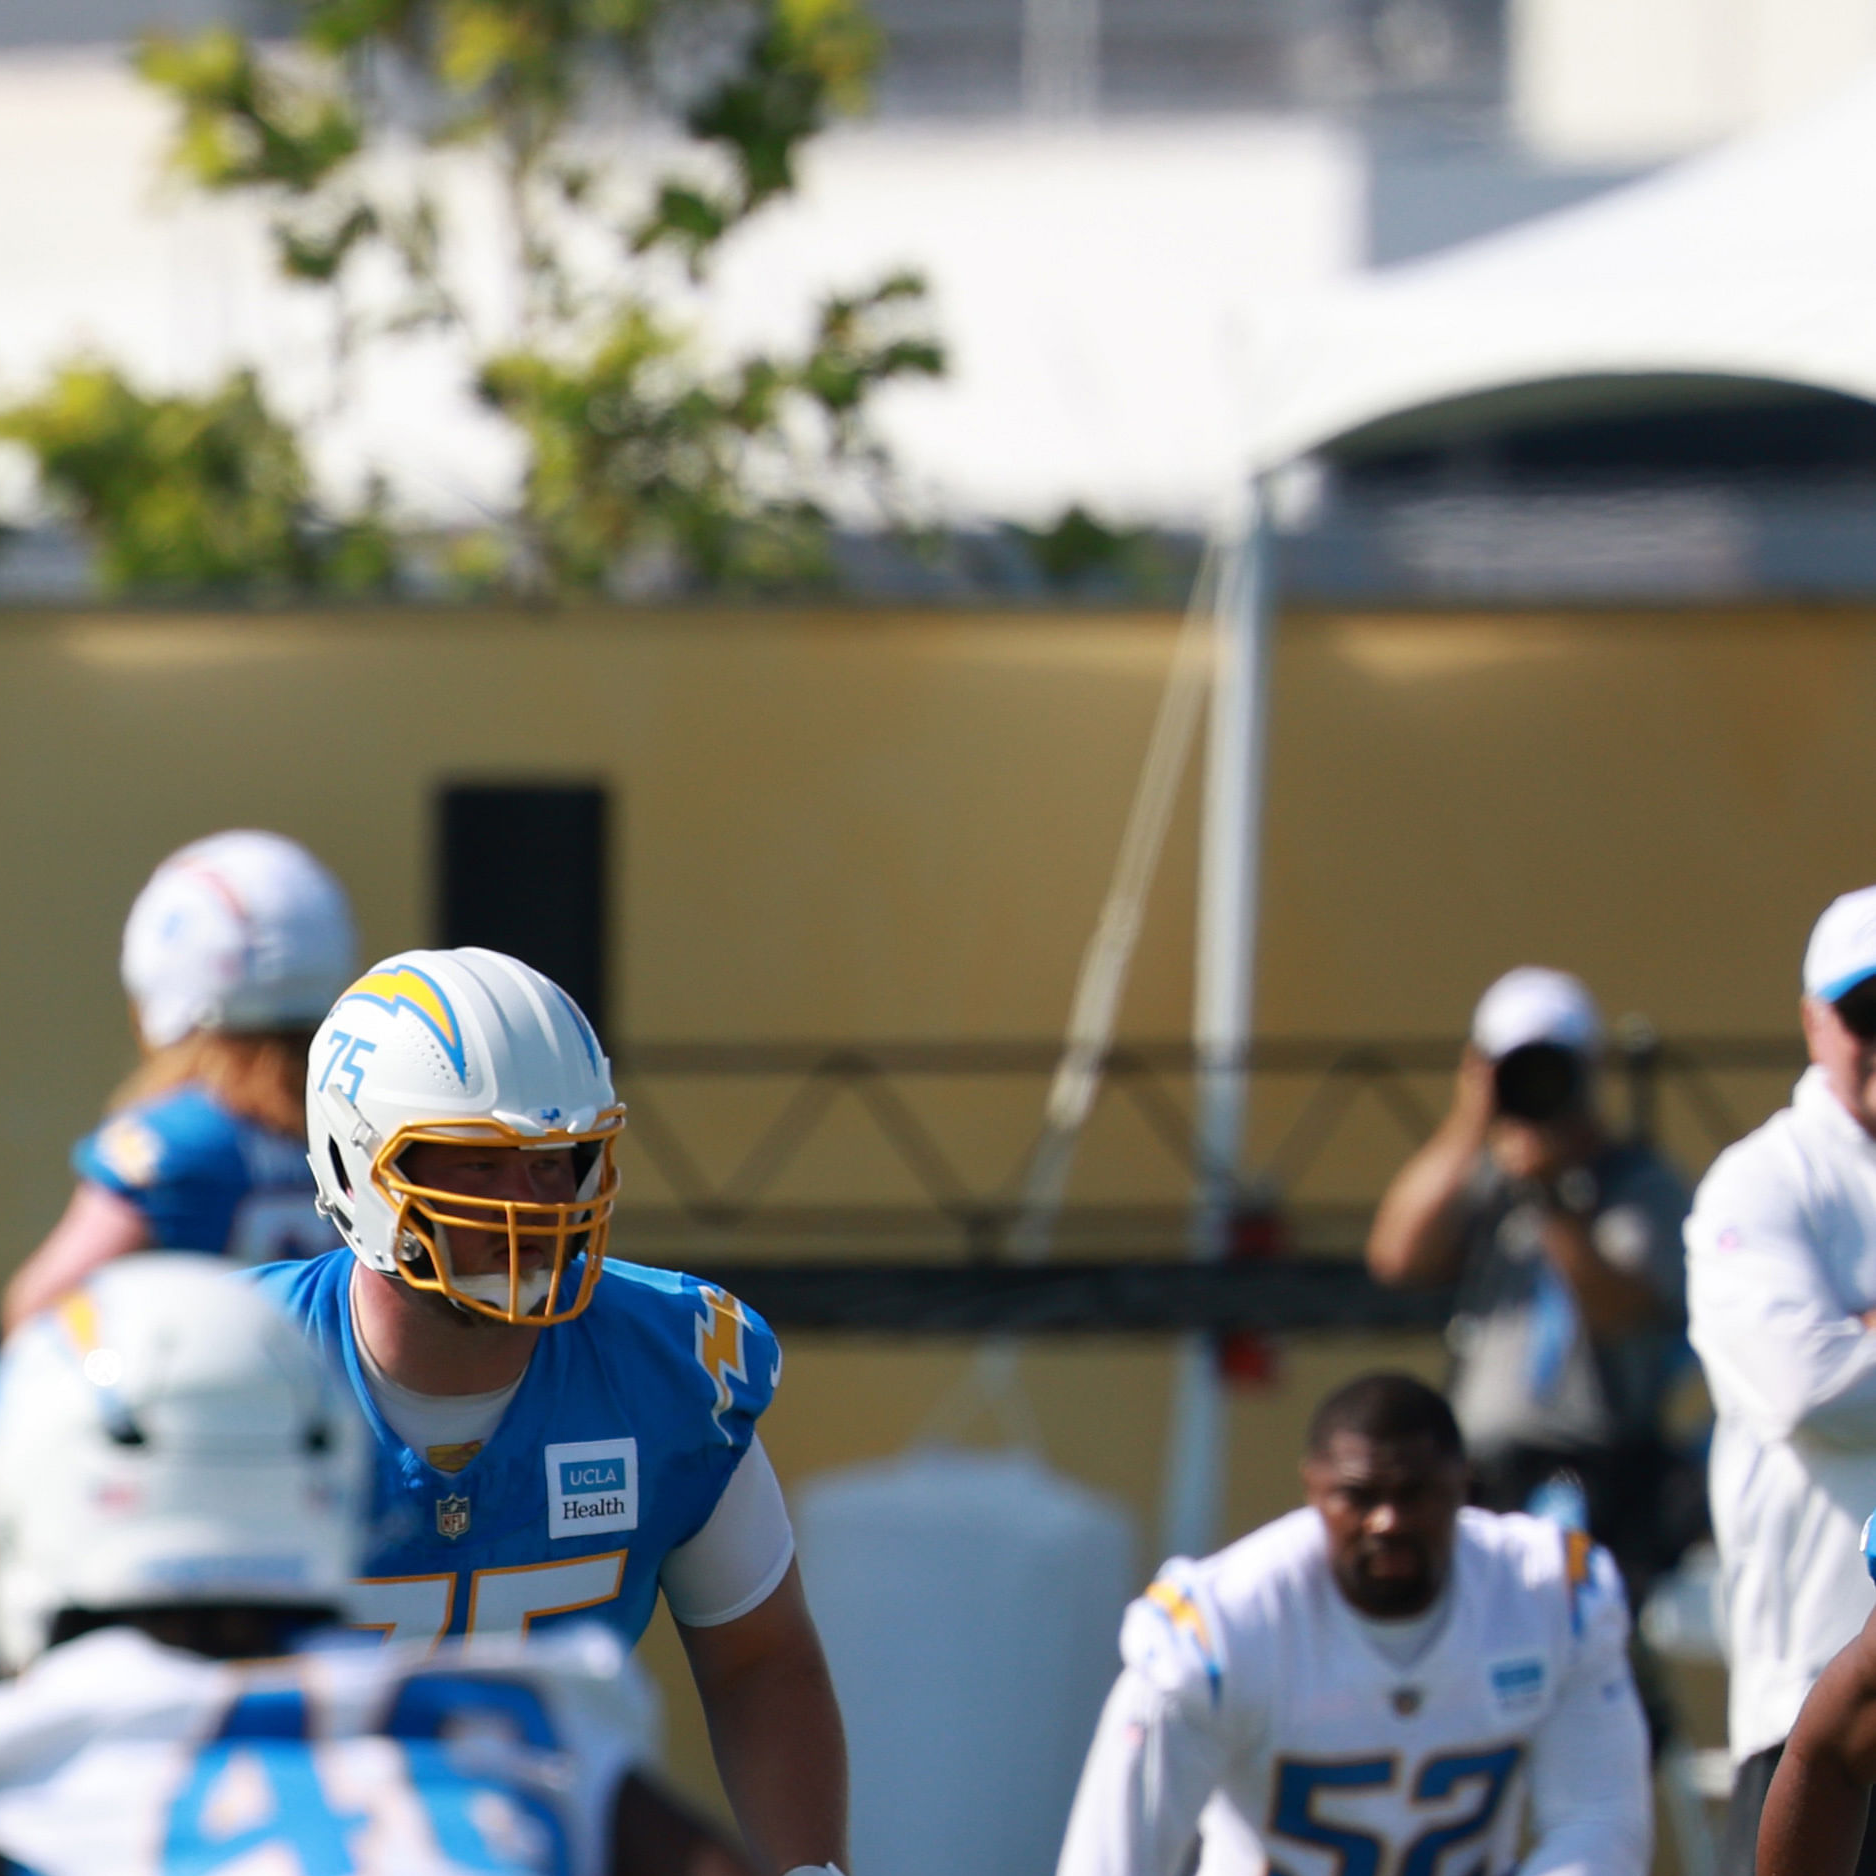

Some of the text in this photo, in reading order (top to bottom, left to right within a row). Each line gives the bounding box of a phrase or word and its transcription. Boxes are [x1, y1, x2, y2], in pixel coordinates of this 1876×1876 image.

[318, 1029, 378, 1105] 75
[568, 1467, 617, 1487] UCLA
[561, 1497, 626, 1521] Health
